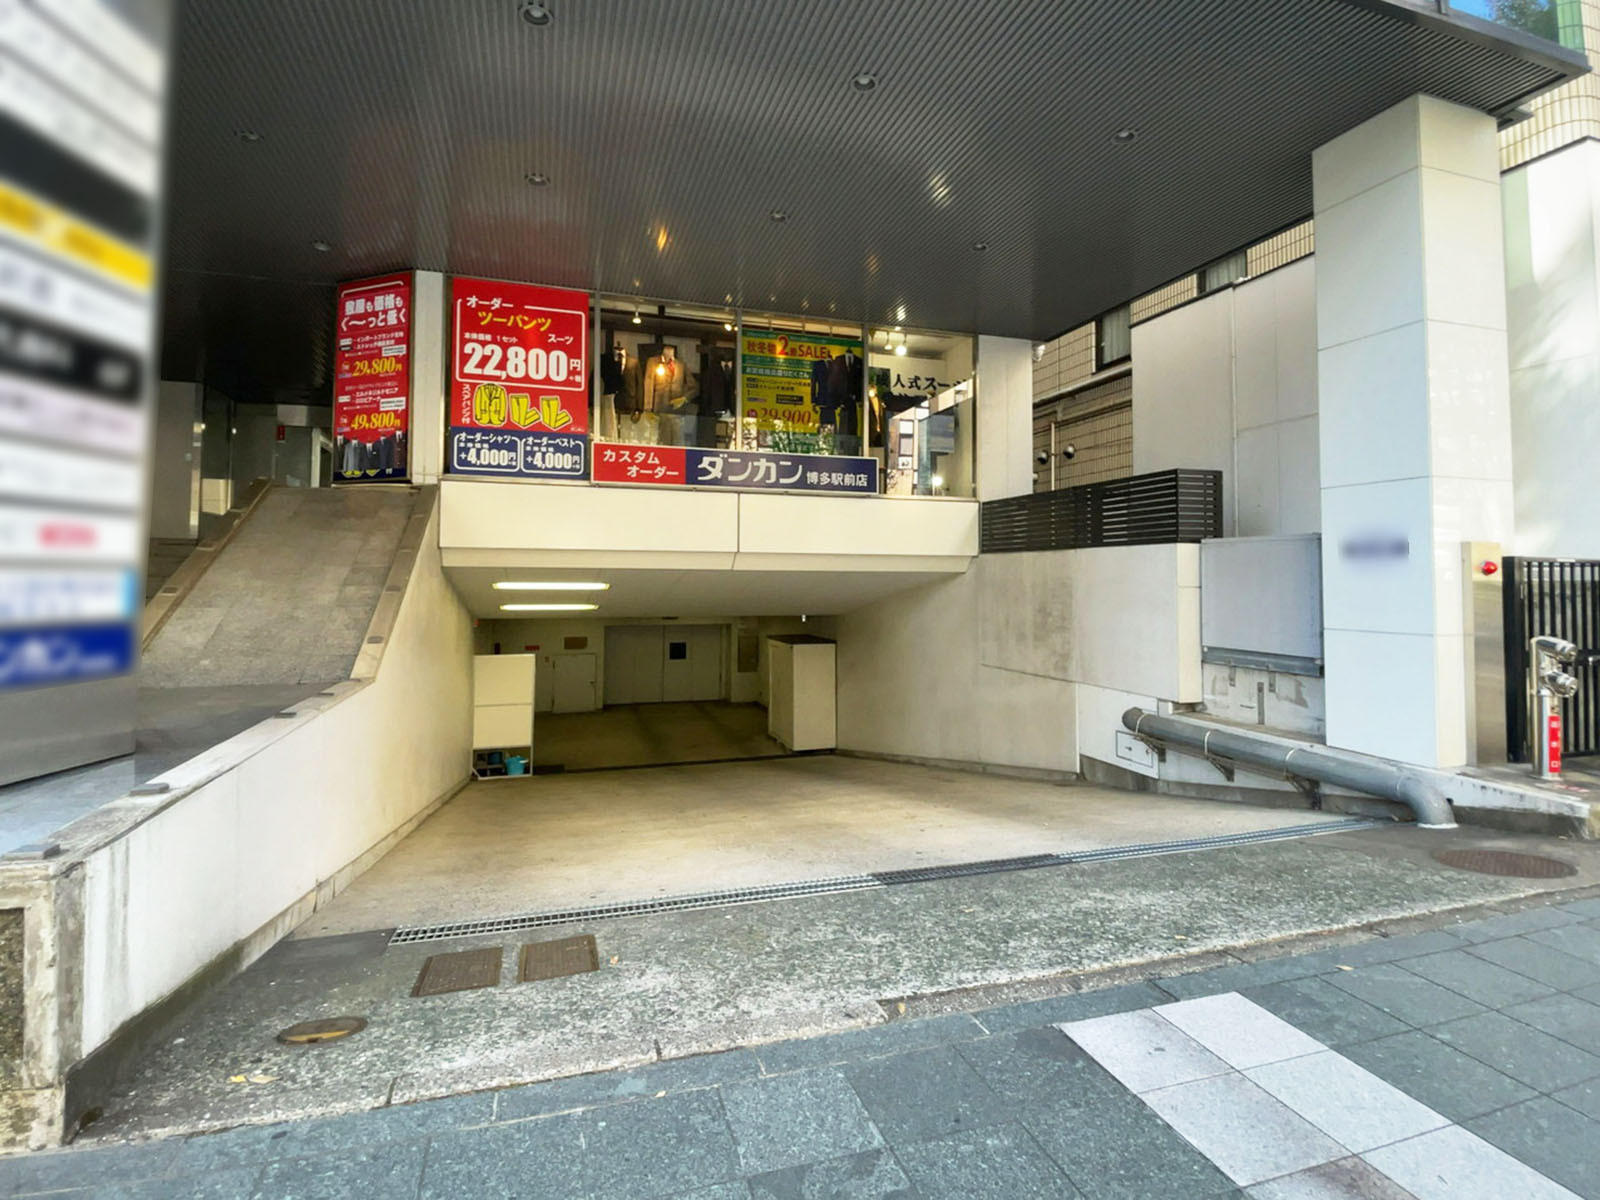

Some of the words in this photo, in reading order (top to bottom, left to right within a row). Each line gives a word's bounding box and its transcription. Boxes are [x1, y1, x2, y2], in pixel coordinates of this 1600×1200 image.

[466, 295, 514, 310] オーダー
[478, 311, 551, 331] ツーパンツ
[548, 333, 574, 345] スーツ
[459, 432, 511, 443] オーダーシャツ
[526, 436, 576, 448] オーダーベスト
[603, 450, 660, 464] カスタム
[627, 465, 679, 479] オーダー
[697, 453, 802, 485] ダンカン
[806, 471, 868, 487] 博多駅前店
